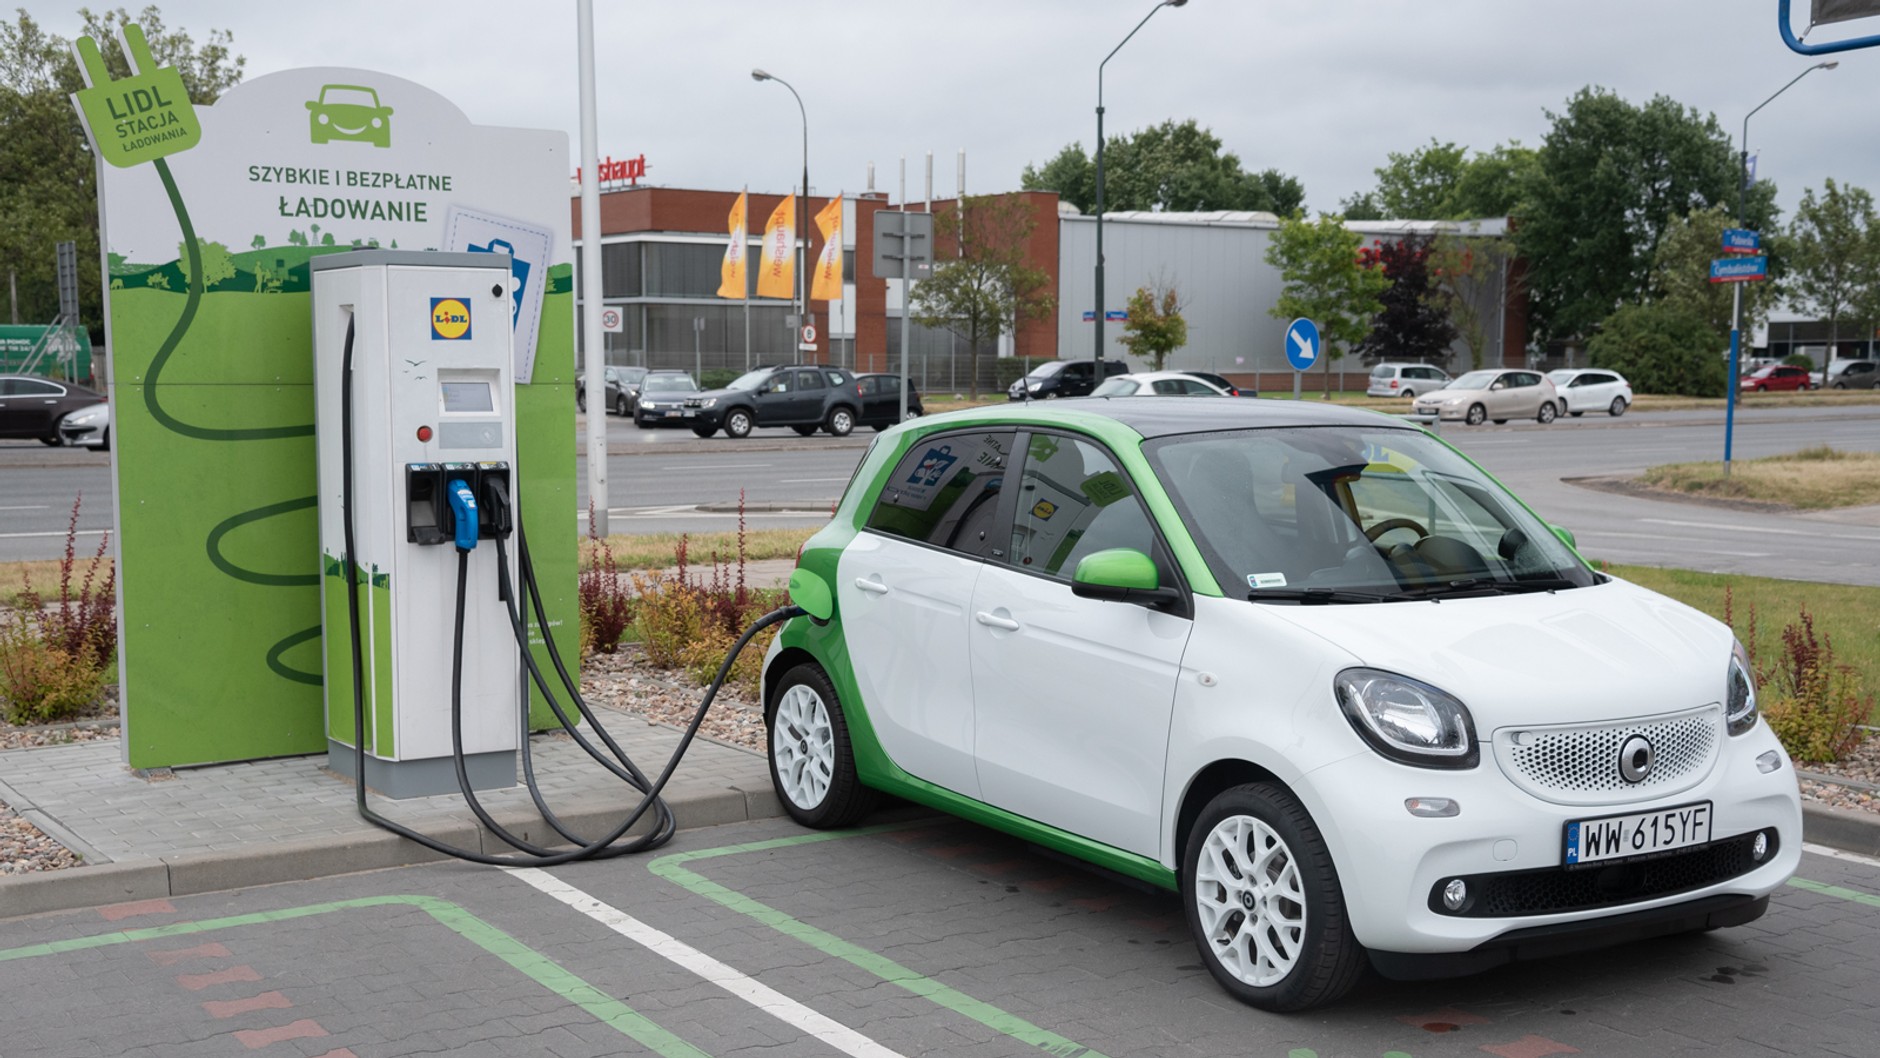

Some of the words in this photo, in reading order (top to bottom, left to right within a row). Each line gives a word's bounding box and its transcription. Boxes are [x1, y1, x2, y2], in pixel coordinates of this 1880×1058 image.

[105, 85, 173, 120] LIDL
[115, 110, 180, 138] STACJA
[122, 127, 188, 152] ŁADOWANIA
[248, 165, 330, 186] SZYBKIE
[335, 170, 341, 186] I
[346, 170, 452, 191] BEZPŁATNE
[278, 195, 428, 222] ŁADOWANIE
[606, 314, 617, 324] 30
[1585, 821, 1623, 857] WW
[1631, 807, 1707, 850] 615YF
[1567, 847, 1577, 857] PL
